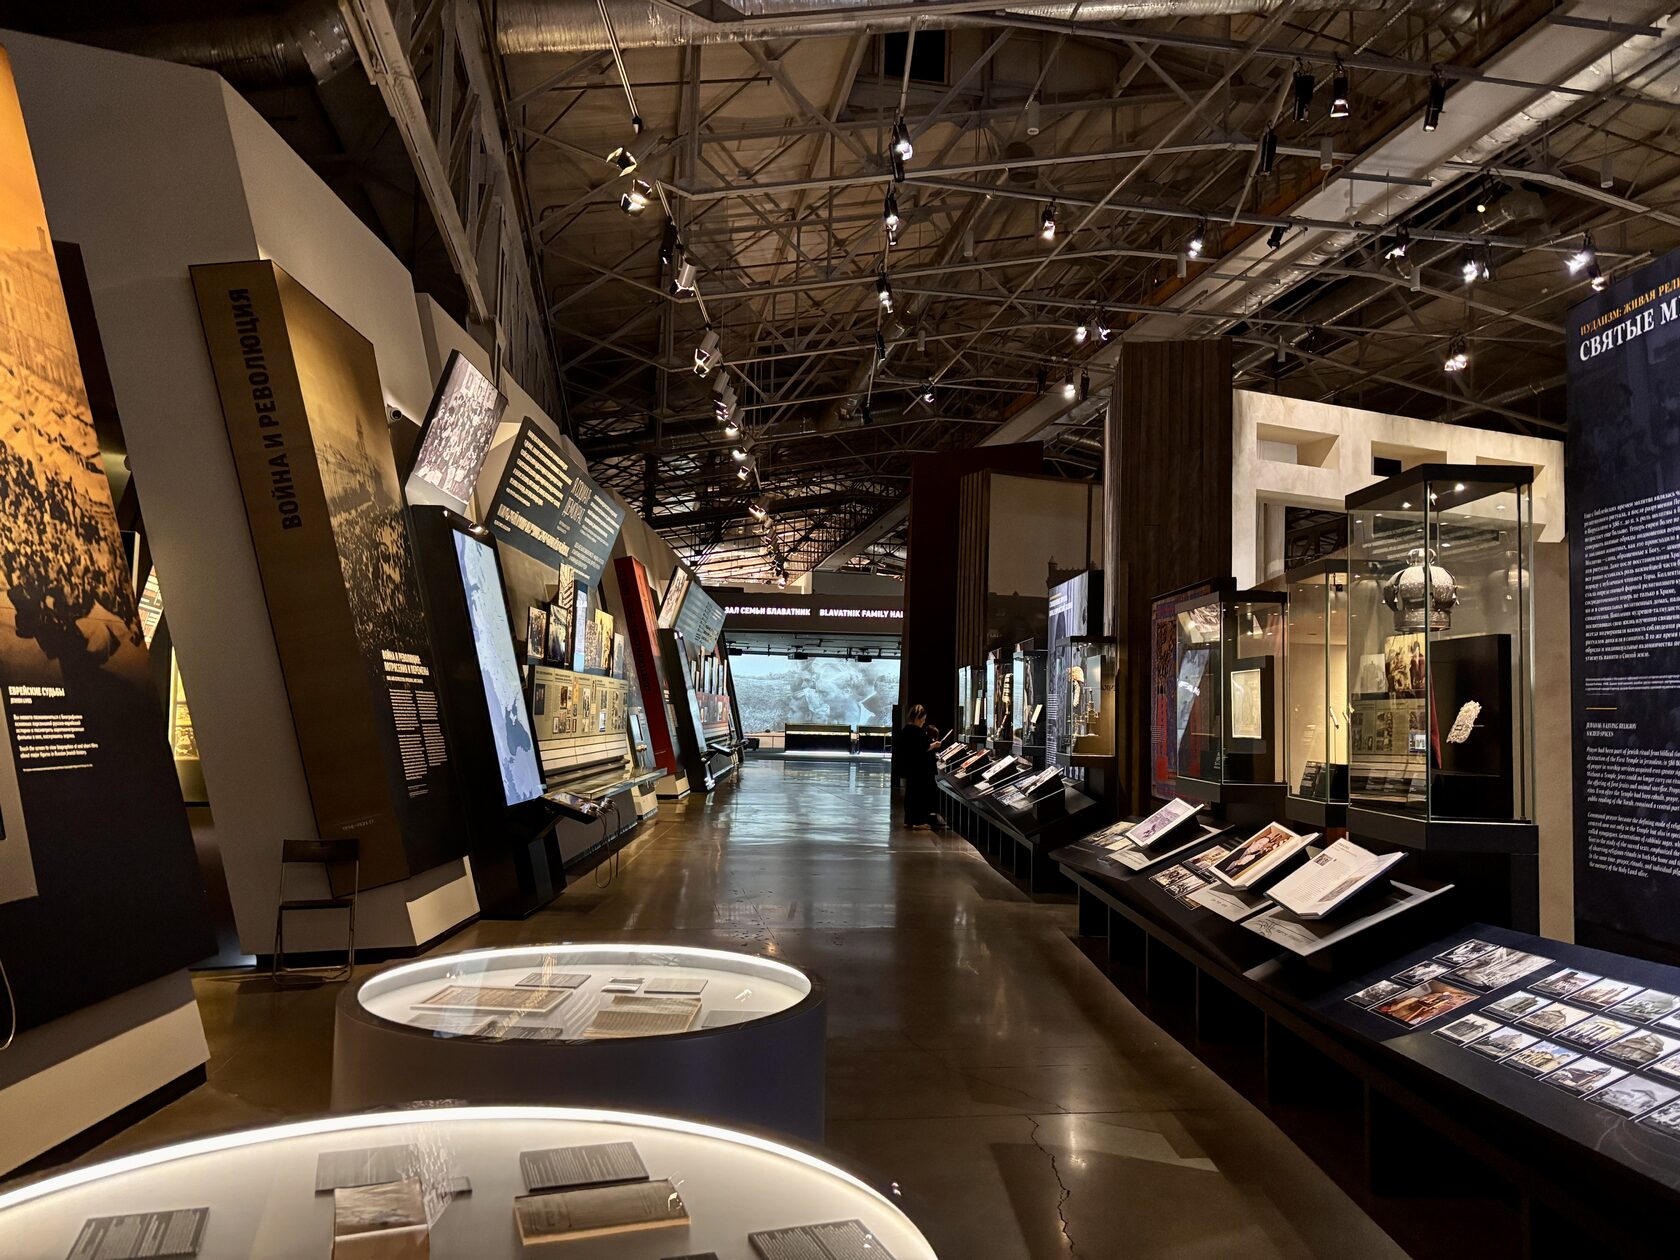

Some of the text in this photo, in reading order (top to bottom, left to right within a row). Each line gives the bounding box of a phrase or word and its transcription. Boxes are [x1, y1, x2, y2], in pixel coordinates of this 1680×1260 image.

[1624, 289, 1656, 314] ЖИВАЯ
[1580, 308, 1654, 361] СВЯТЫЕ
[228, 288, 302, 529] ВОЙНА И РЕВОЛЮЦИЯ
[766, 608, 810, 616] БЛАВАТНИК
[820, 608, 860, 616] BLAVATNIK
